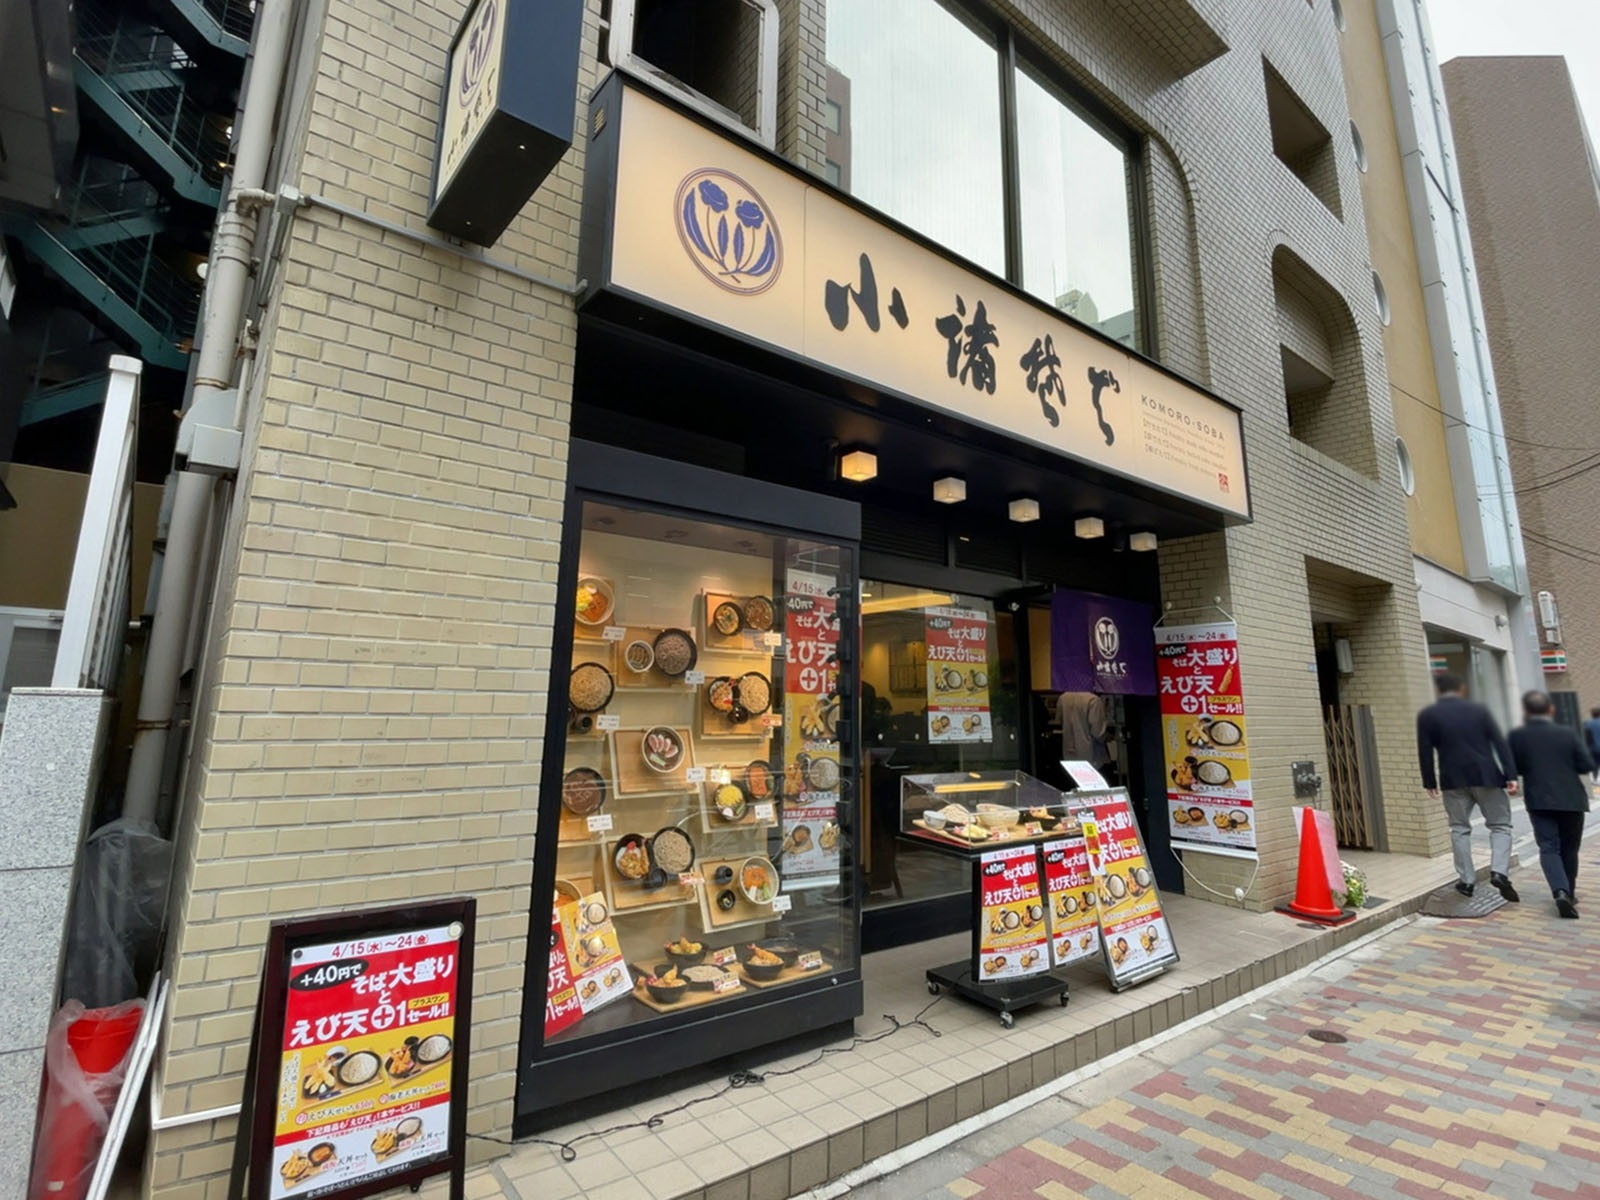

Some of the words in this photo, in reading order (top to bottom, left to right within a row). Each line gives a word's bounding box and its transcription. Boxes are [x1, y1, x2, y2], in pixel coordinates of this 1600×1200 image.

[1171, 647, 1238, 668] そば大盛り
[1160, 675, 1216, 695] えび天
[350, 954, 454, 995] そば大盛り
[378, 991, 392, 1004] と
